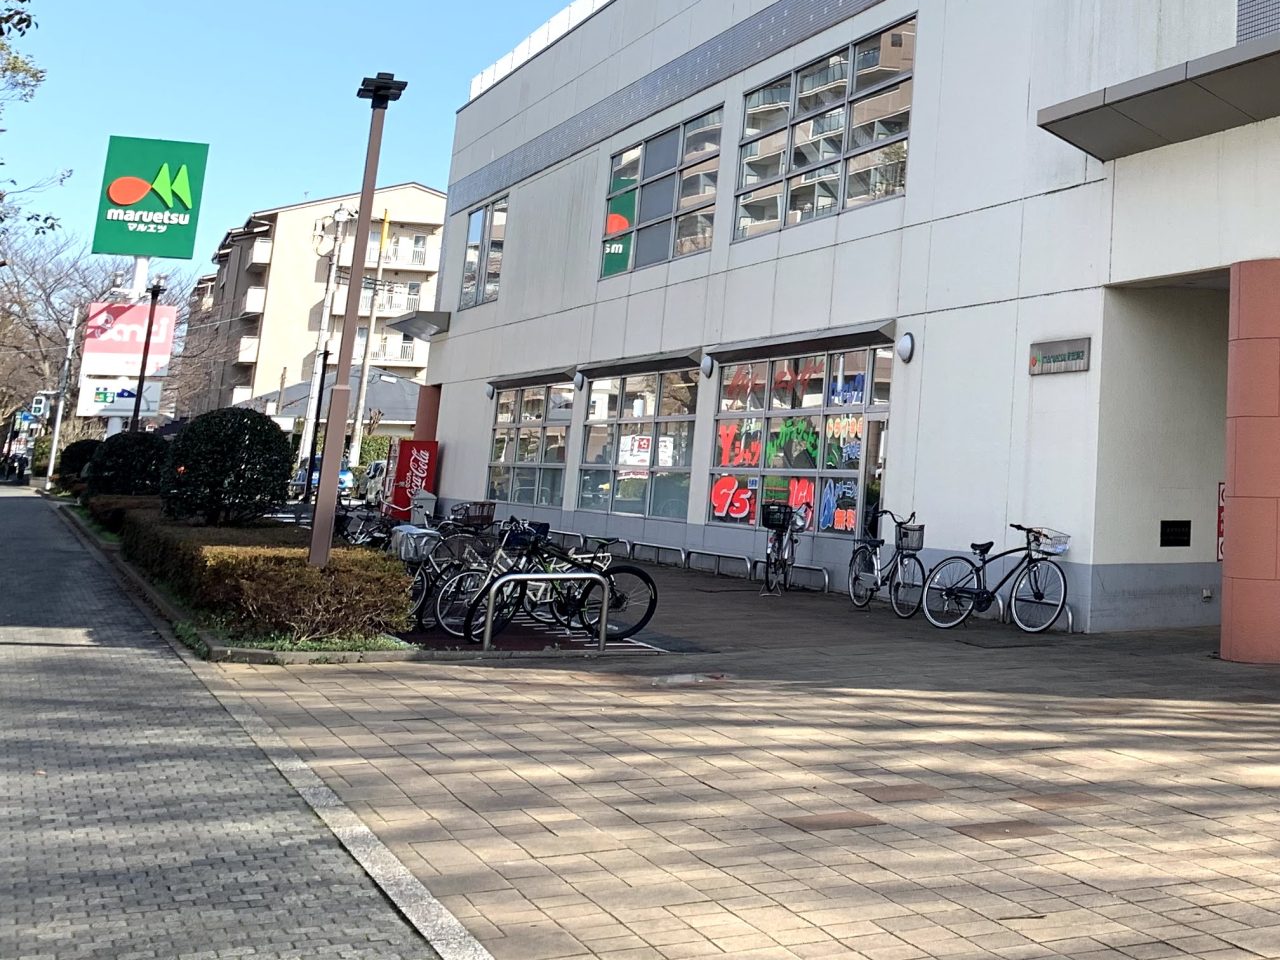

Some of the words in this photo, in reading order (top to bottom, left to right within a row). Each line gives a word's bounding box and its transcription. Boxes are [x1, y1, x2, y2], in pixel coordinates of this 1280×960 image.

[106, 208, 190, 225] maruetsu
[127, 222, 168, 233] マルエツ
[720, 425, 761, 465] Yシャツ
